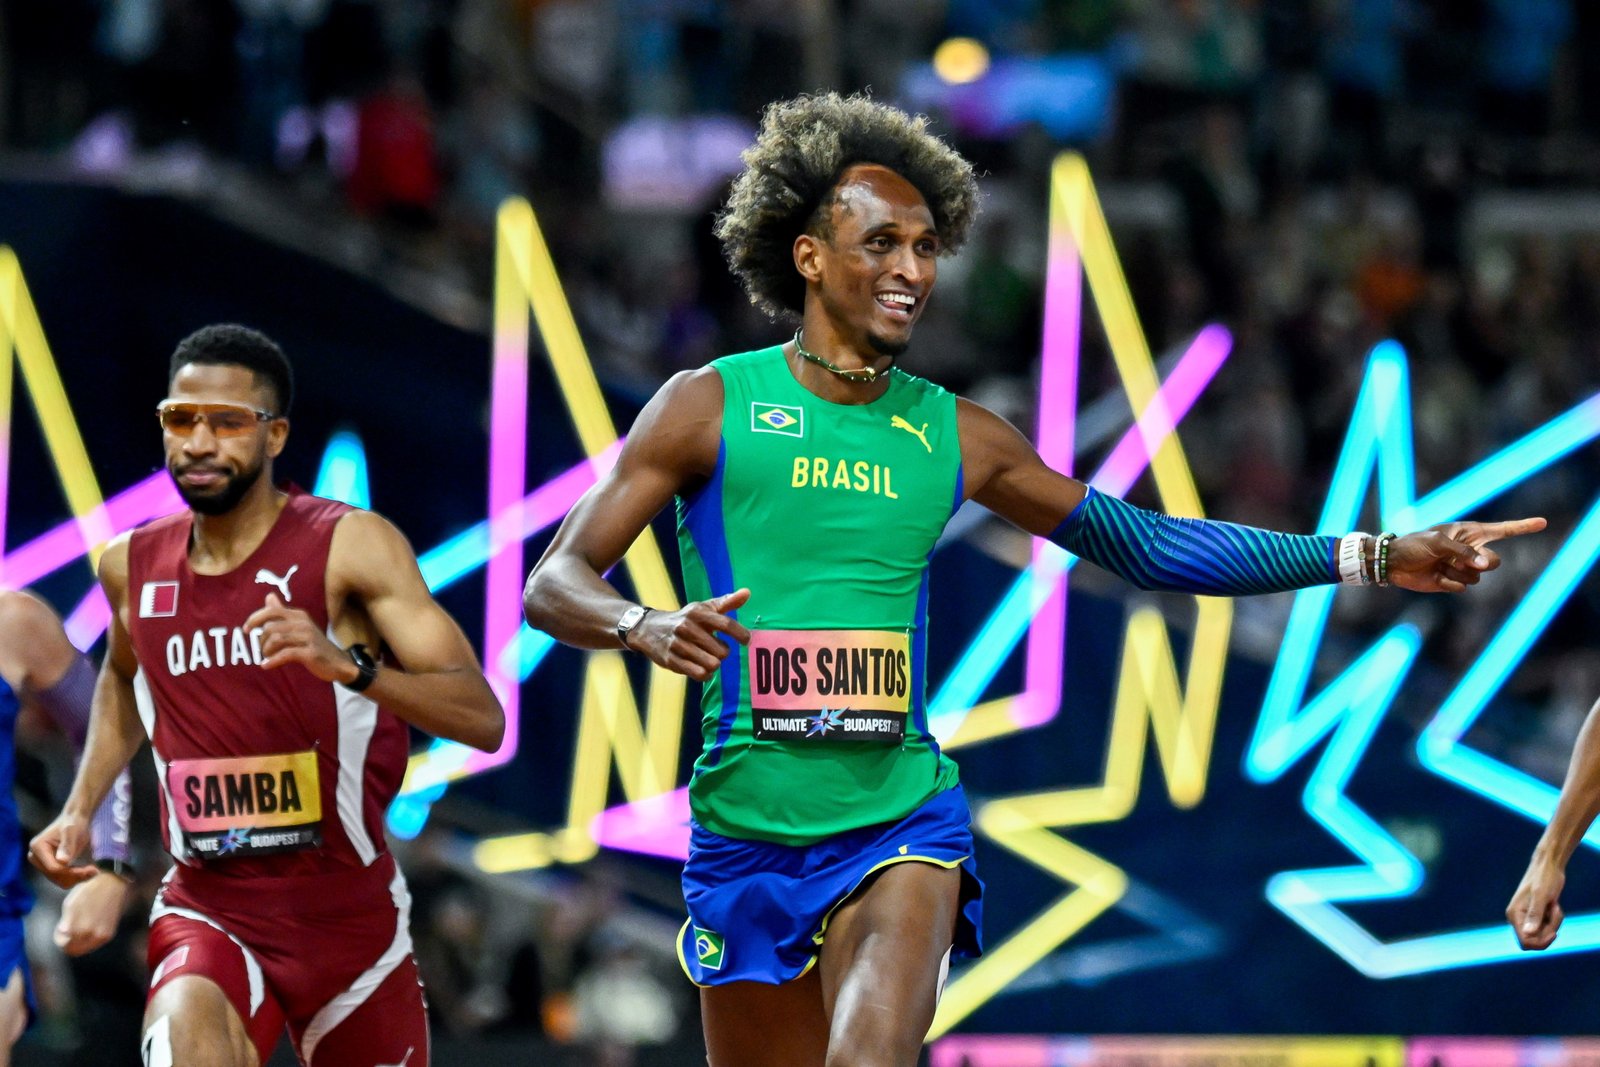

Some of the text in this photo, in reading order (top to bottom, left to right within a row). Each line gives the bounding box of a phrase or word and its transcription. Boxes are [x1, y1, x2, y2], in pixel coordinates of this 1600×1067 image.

[791, 457, 898, 499] BRASIL
[756, 647, 907, 698] DOS SANTOS
[762, 717, 807, 732] ULTIMATE
[844, 718, 891, 732] BUDAPEST
[184, 771, 302, 819] SAMBA
